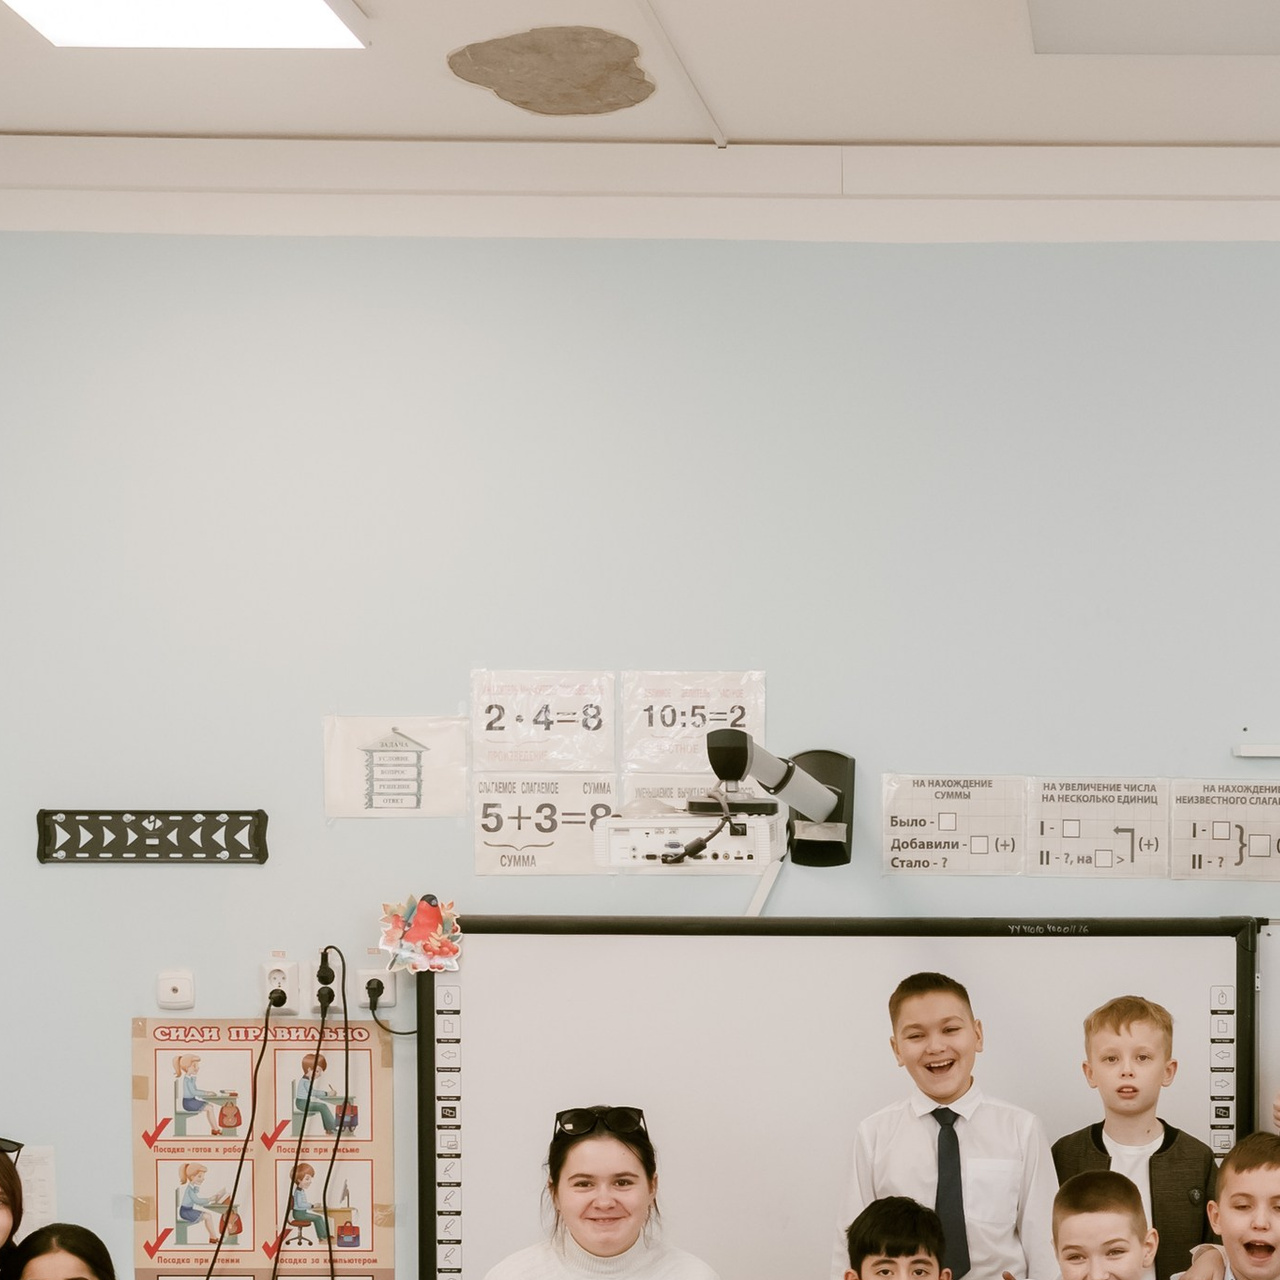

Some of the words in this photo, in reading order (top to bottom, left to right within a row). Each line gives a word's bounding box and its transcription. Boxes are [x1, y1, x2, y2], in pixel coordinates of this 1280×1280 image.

[643, 704, 746, 728] 10:5=2
[478, 781, 517, 794] СЛАГАЕМОЕ
[520, 782, 559, 794] СЛАГАЕМОЕ
[582, 782, 612, 795] СУММА
[912, 780, 926, 788] НА
[928, 780, 993, 789] НАХОЖДЕНИЕ
[1043, 782, 1057, 791] НА
[1059, 783, 1121, 792] УВЕЛИЧЕНИЕ
[1124, 784, 1157, 793] ЧИСЛА
[1203, 785, 1216, 793] НА
[677, 787, 716, 798] ВЫЧИТАЕМО
[934, 791, 971, 800] СУММЫ
[1042, 794, 1055, 803] НА
[1057, 794, 1115, 803] НЕСКОЛЬКО
[1117, 795, 1158, 805] ЕДИНИЦ
[1175, 796, 1247, 805] НЕИЗВЕСТНОГО
[481, 802, 612, 833] 5+3=8
[890, 815, 927, 827] Было
[890, 838, 959, 852] Добавили
[500, 854, 537, 867] СУММА
[890, 857, 930, 868] Стало
[1077, 855, 1093, 864] на
[153, 1026, 220, 1043] СИДИ
[228, 1026, 370, 1043] ПРАВИЛЬНО
[153, 1145, 185, 1154] Посадка
[276, 1145, 310, 1154] Посака
[313, 1147, 328, 1155] при
[157, 1256, 191, 1264] Посадка
[194, 1257, 209, 1265] при
[276, 1256, 307, 1264] осадка
